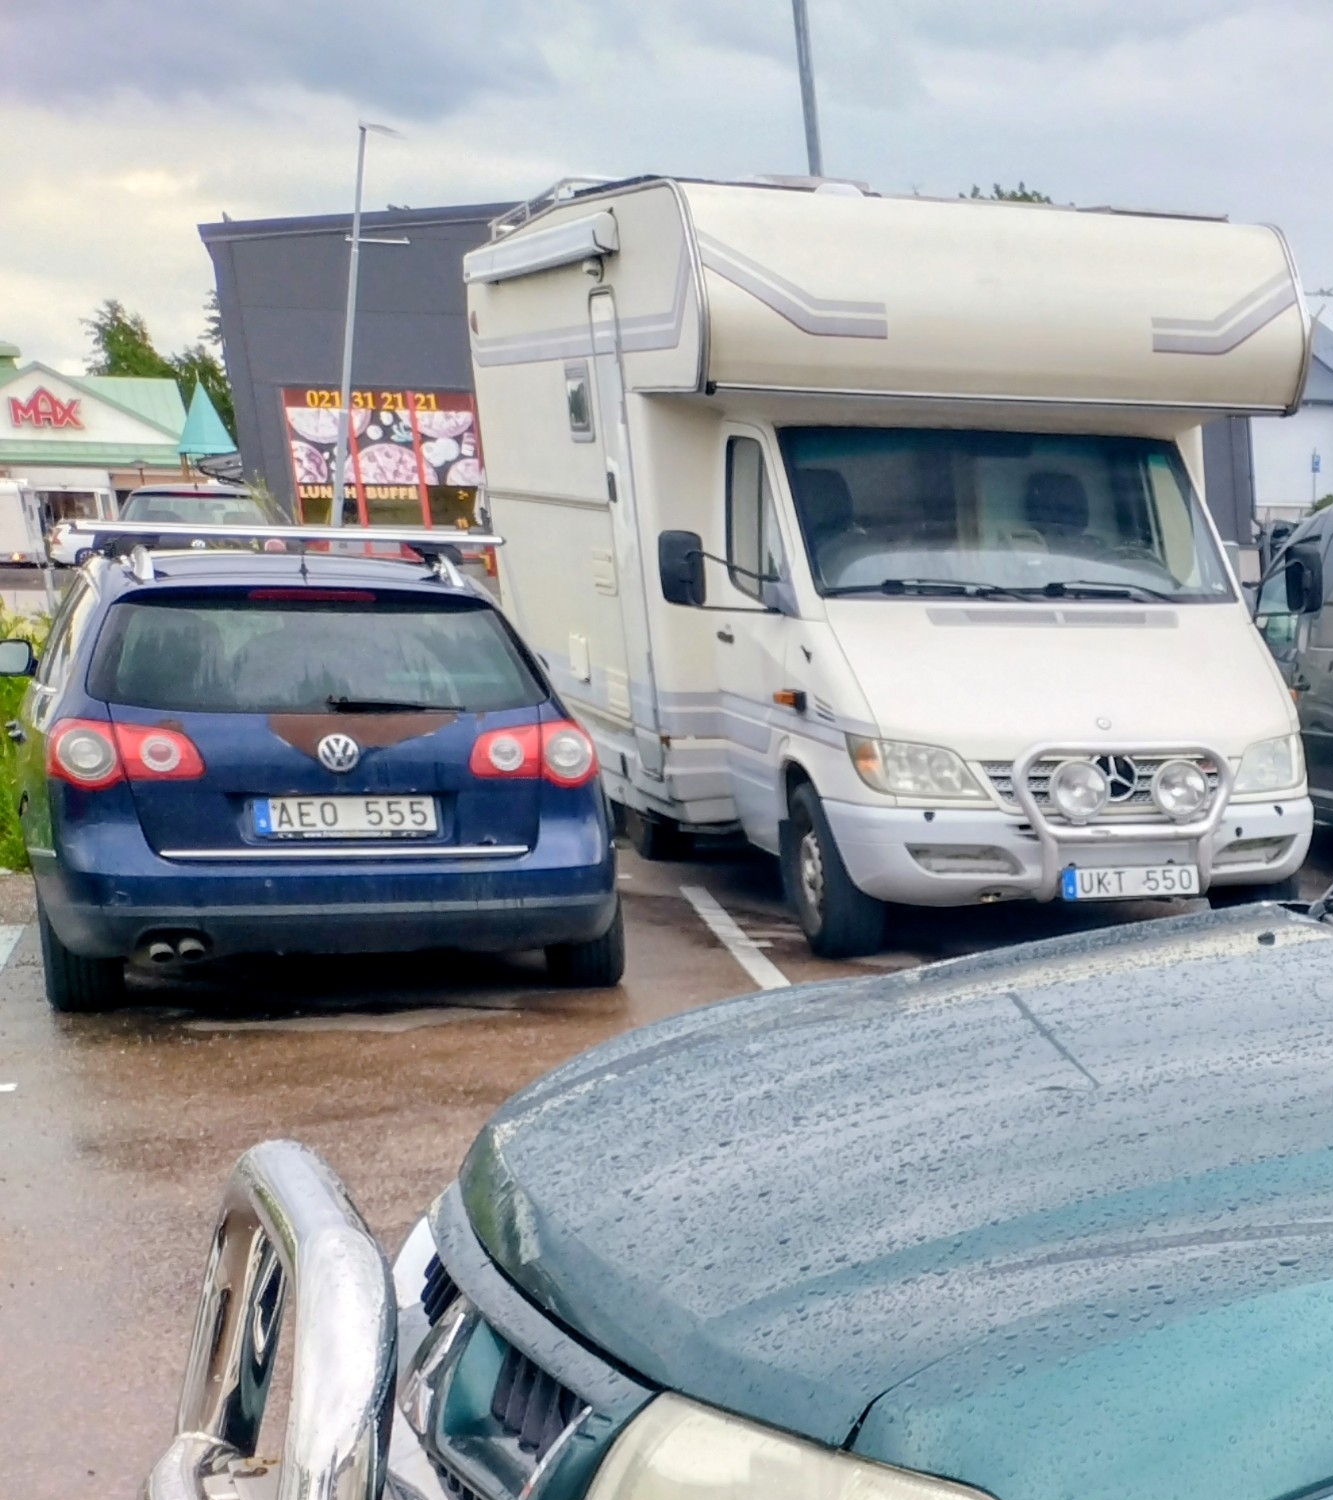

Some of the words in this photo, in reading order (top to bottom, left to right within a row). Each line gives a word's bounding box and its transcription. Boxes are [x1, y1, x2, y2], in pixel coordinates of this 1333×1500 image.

[8, 386, 85, 429] MAX
[306, 390, 342, 409] 021
[351, 391, 375, 410] 31
[381, 392, 405, 410] 21
[414, 393, 438, 411] 21
[300, 485, 357, 500] LUNH
[277, 801, 339, 829] AEO
[365, 801, 428, 826] 555
[1080, 871, 1127, 894] UKT
[1145, 869, 1192, 892] 550
